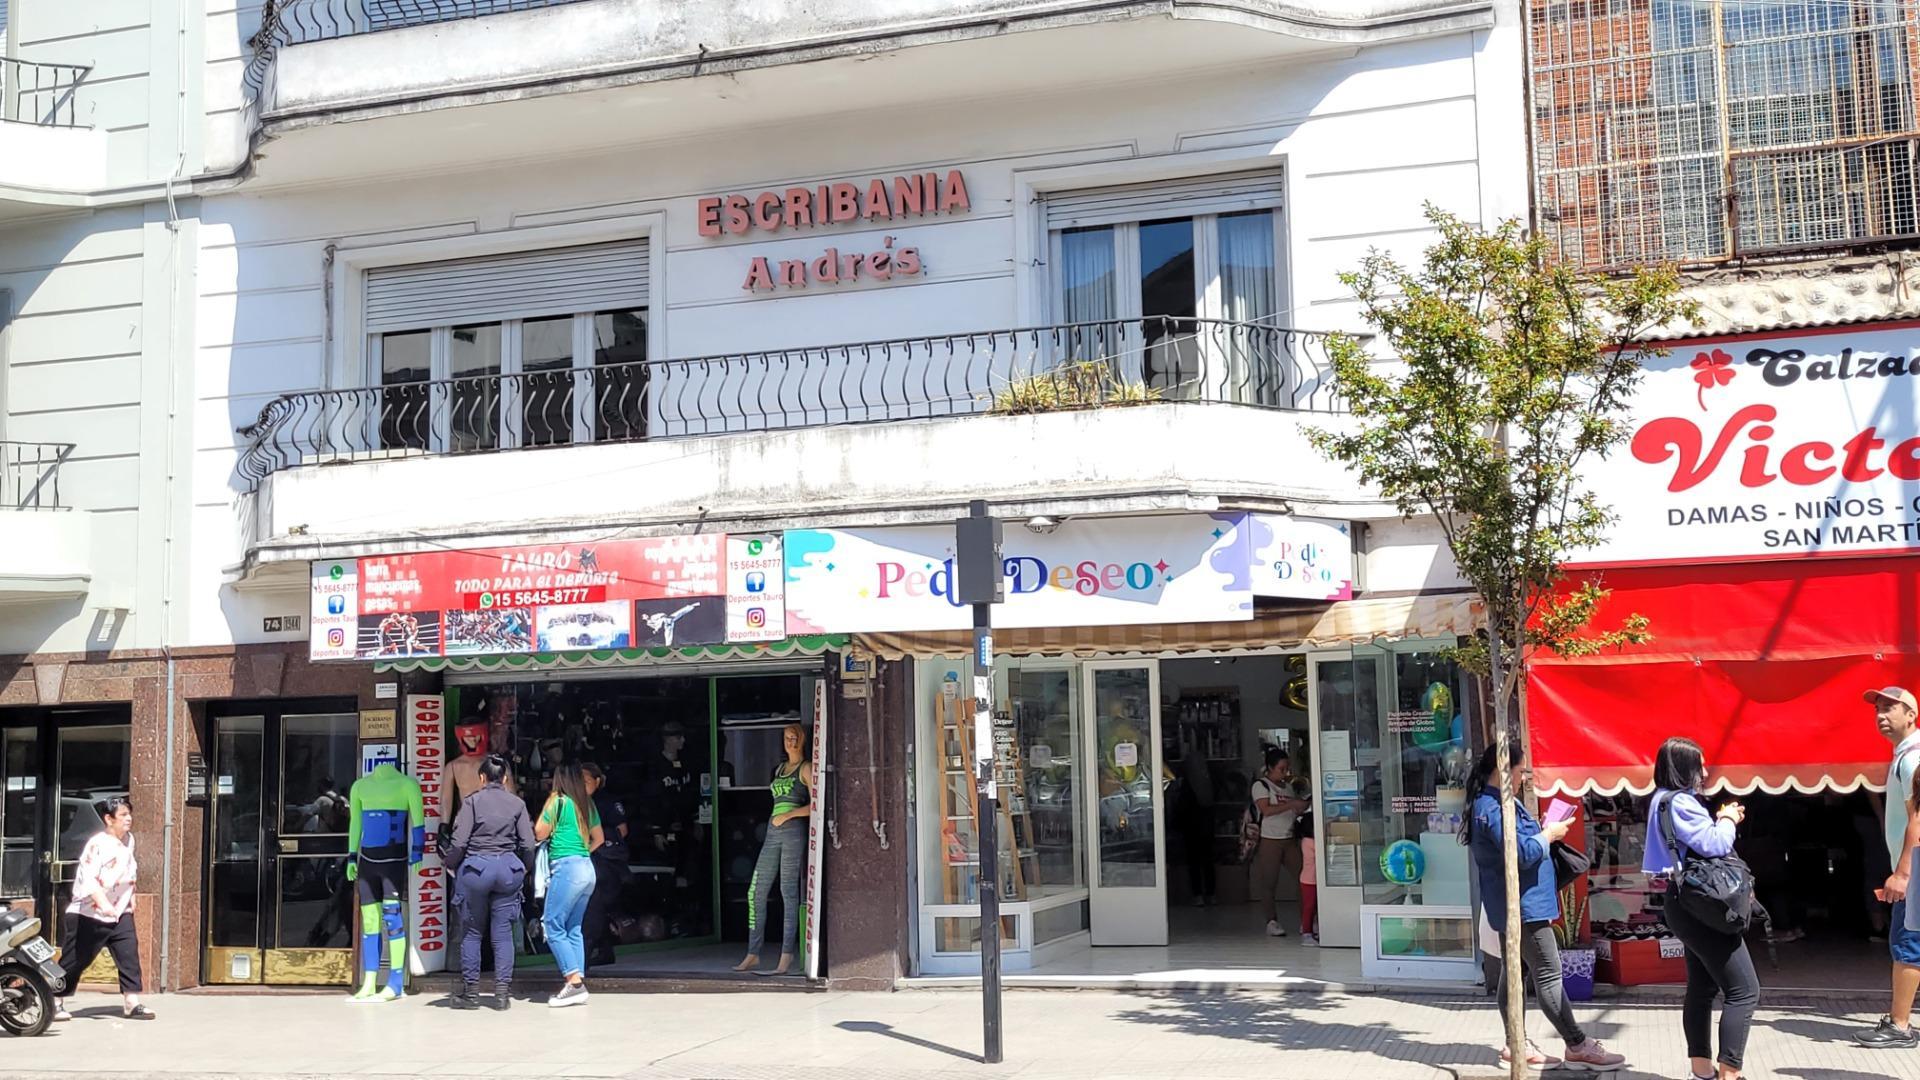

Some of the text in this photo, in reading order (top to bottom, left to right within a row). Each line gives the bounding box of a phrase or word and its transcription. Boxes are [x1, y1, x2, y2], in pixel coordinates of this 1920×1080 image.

[698, 169, 971, 237] ESCRIBANIA
[1667, 504, 1768, 526] DAMAS
[1795, 495, 1885, 520] NIÑOS
[1763, 527, 1822, 548] SAN
[454, 578, 490, 593] TODO
[493, 576, 532, 591] PARA
[494, 588, 589, 606] 15 5645-8777
[728, 594, 761, 604] Deportes
[876, 557, 967, 607] Ped
[415, 699, 442, 818] COMPOSTURA
[811, 685, 822, 812] COMPOSTURA
[418, 867, 443, 952] CALZADO
